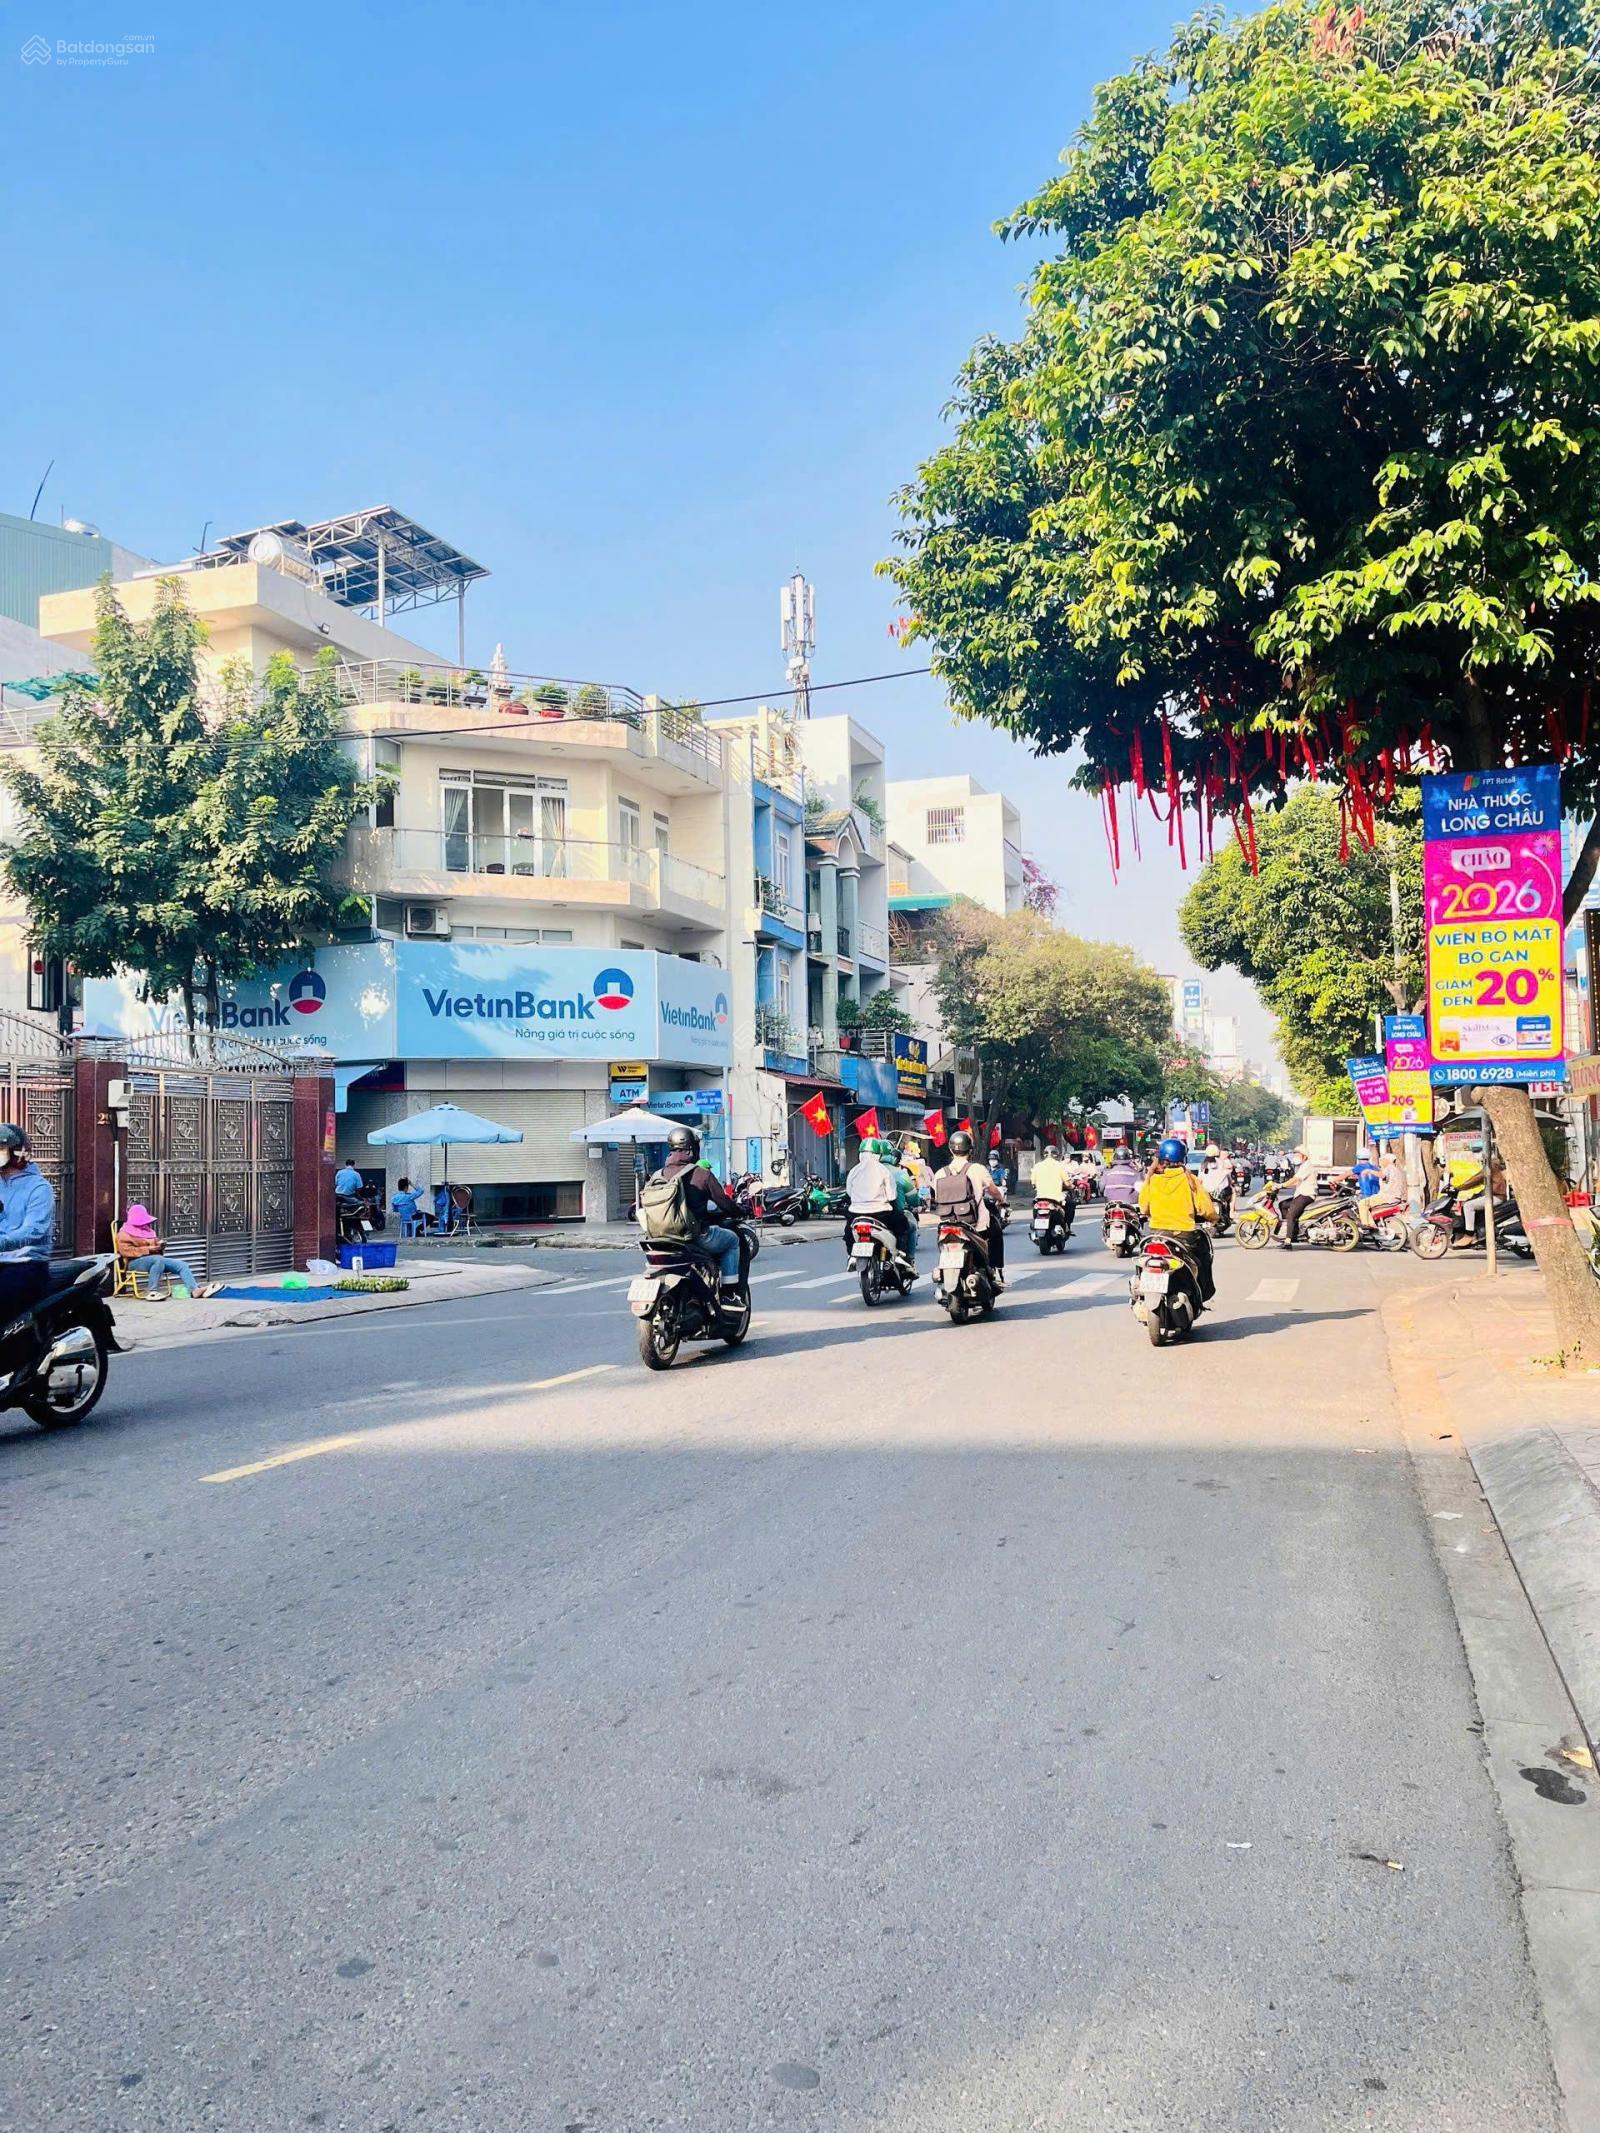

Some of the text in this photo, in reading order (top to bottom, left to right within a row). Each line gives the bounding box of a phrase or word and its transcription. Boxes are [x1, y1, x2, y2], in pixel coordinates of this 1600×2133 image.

[1496, 776, 1516, 785] Retail
[1448, 789, 1532, 811] NHÀ THUỐC
[1441, 808, 1544, 833] LONG CHÂU
[1461, 849, 1504, 867] CHÀO
[1442, 878, 1542, 919] 2026
[1489, 949, 1529, 963] GAN
[422, 988, 595, 1020] VietinBank
[661, 1000, 717, 1032] VietinBank
[1462, 1023, 1501, 1033] SkillMx
[548, 1030, 565, 1041] giá
[1393, 1055, 1424, 1070] 2026
[1446, 1068, 1477, 1080] 1800
[1480, 1068, 1513, 1080] 6928
[620, 1089, 640, 1098] ATM
[1391, 1095, 1414, 1106] 206
